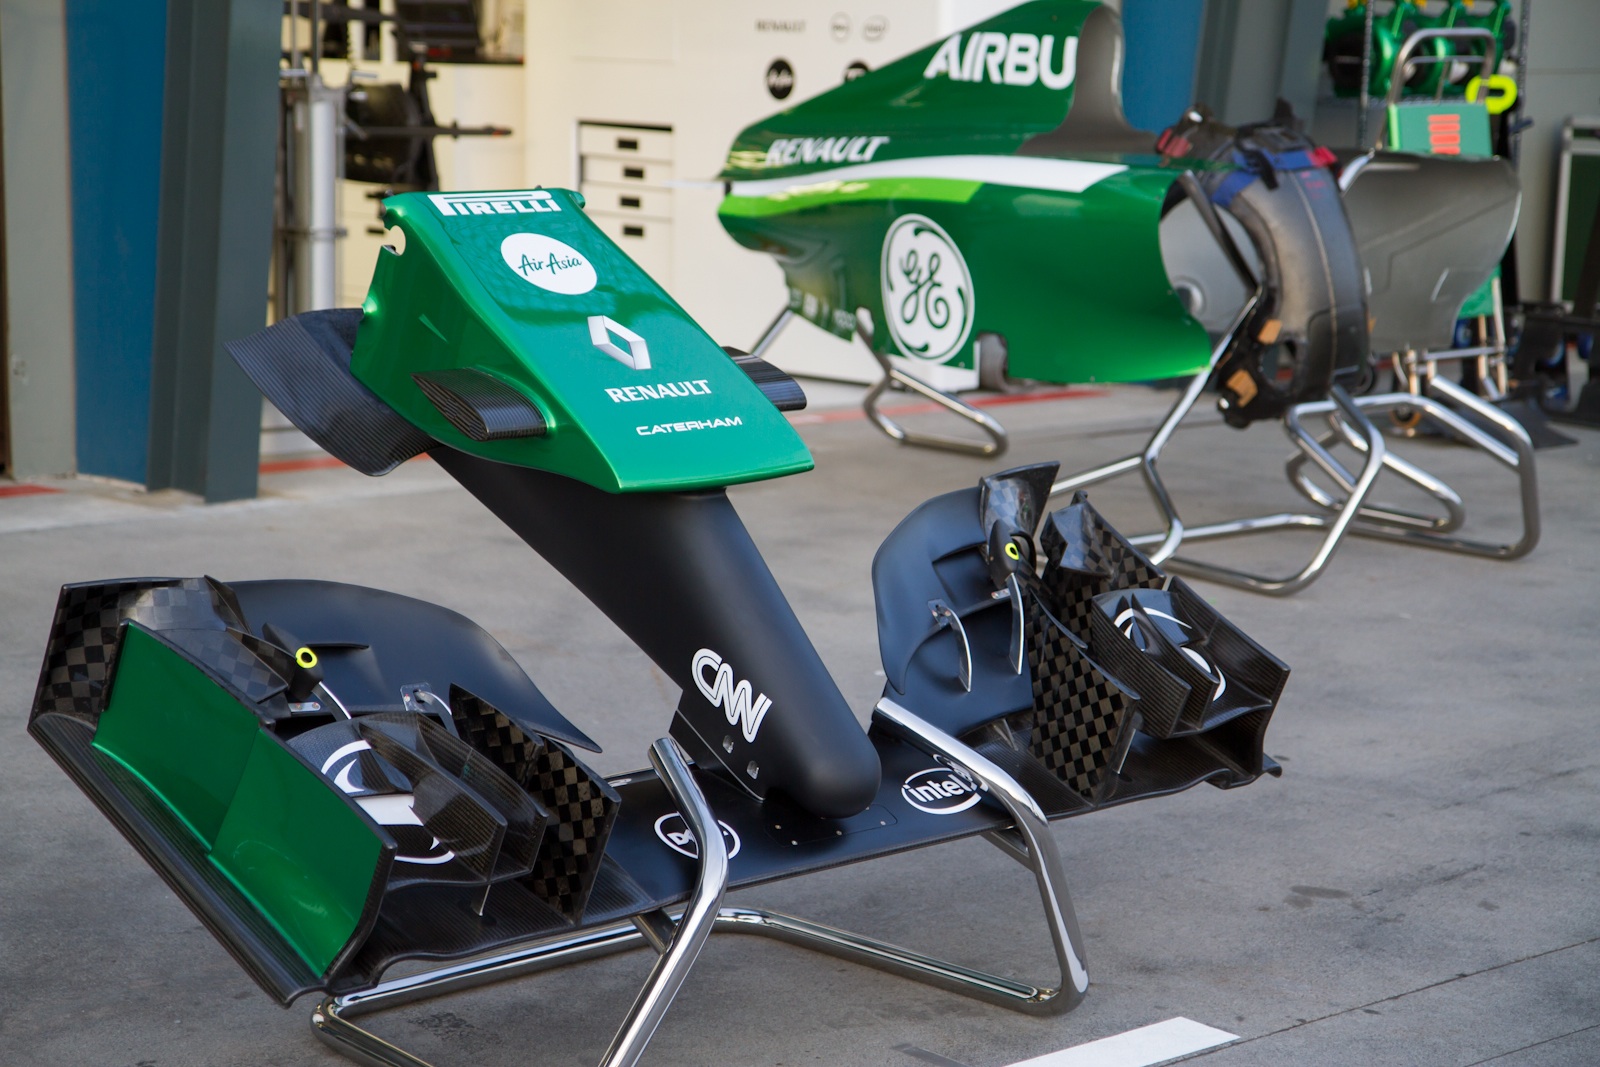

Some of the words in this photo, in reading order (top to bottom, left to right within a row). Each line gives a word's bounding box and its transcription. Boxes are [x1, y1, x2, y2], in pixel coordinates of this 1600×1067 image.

[923, 31, 1079, 90] AIRBU
[765, 136, 890, 167] RENAULT
[427, 190, 562, 216] PIRELLI
[604, 379, 713, 403] RENAULT
[636, 416, 743, 436] CATERHAM
[691, 647, 773, 743] CNN
[902, 774, 973, 803] intel
